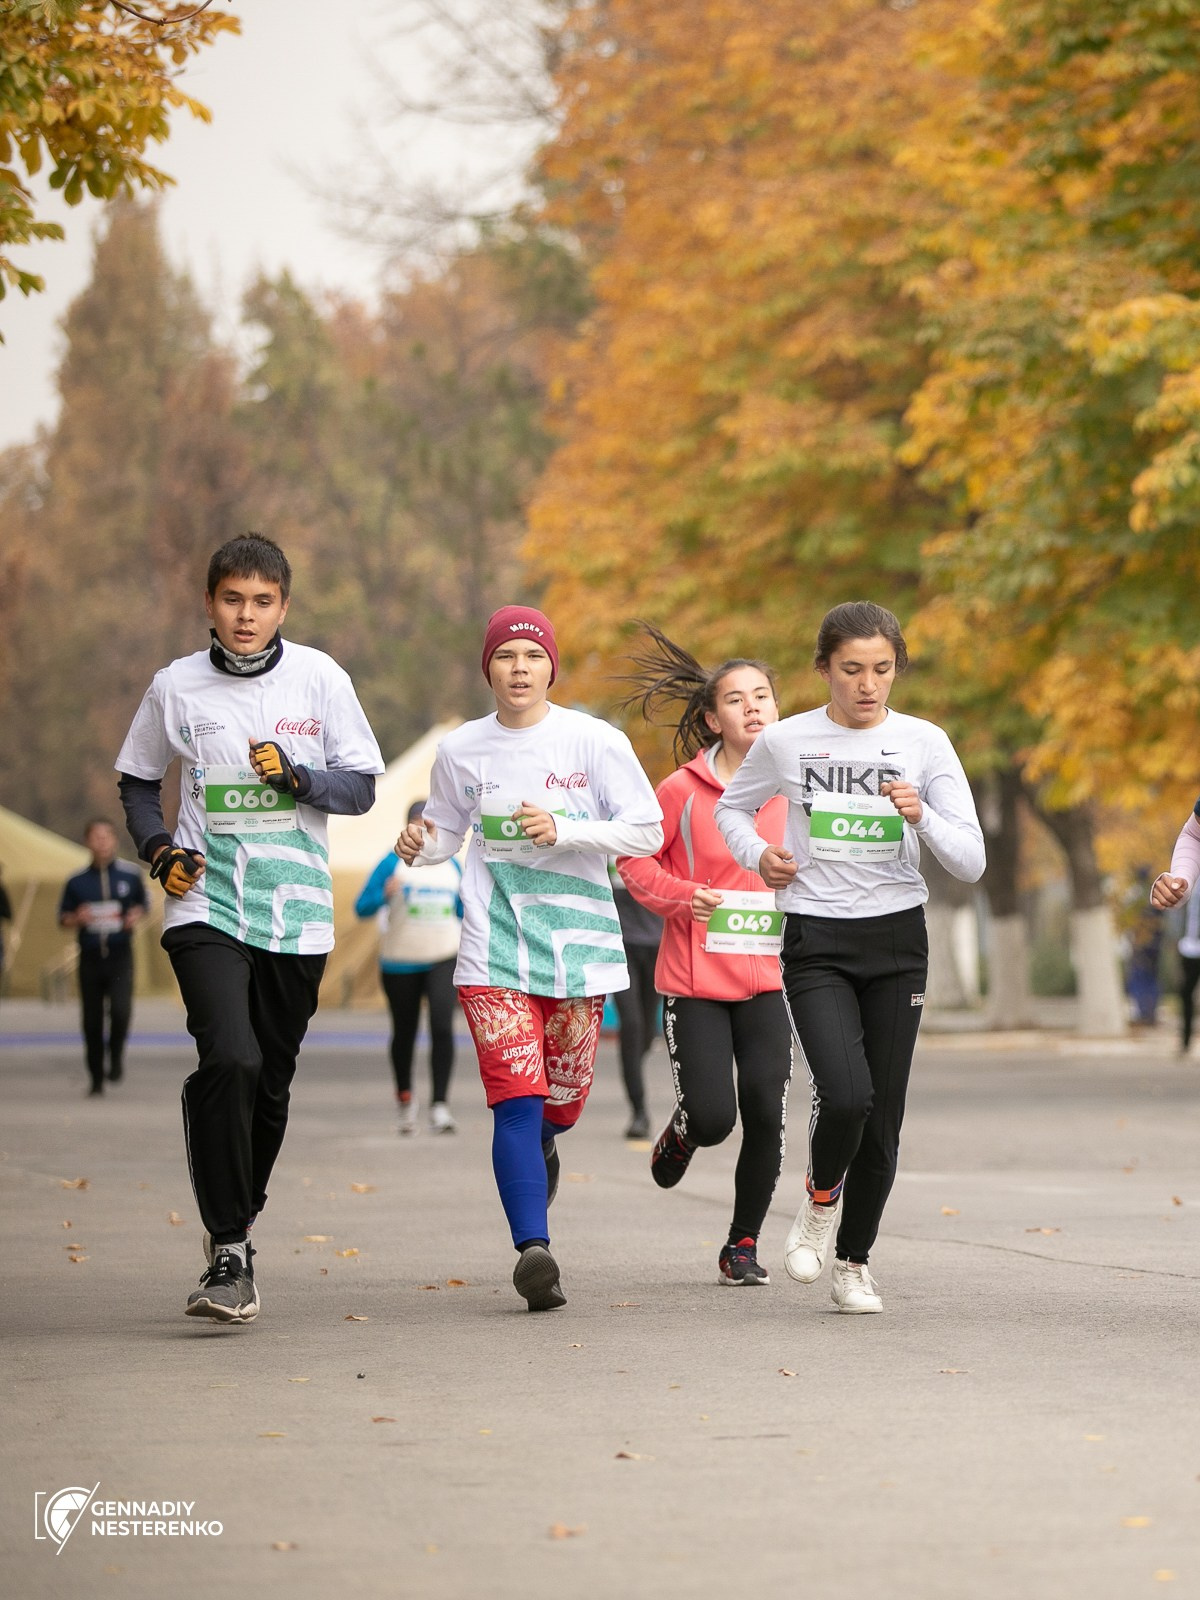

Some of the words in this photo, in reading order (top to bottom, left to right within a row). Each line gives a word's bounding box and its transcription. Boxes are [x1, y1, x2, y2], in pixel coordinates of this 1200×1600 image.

[224, 789, 278, 809] 060
[831, 818, 885, 838] 044
[727, 912, 773, 932] 049
[549, 1083, 581, 1101] NIKE
